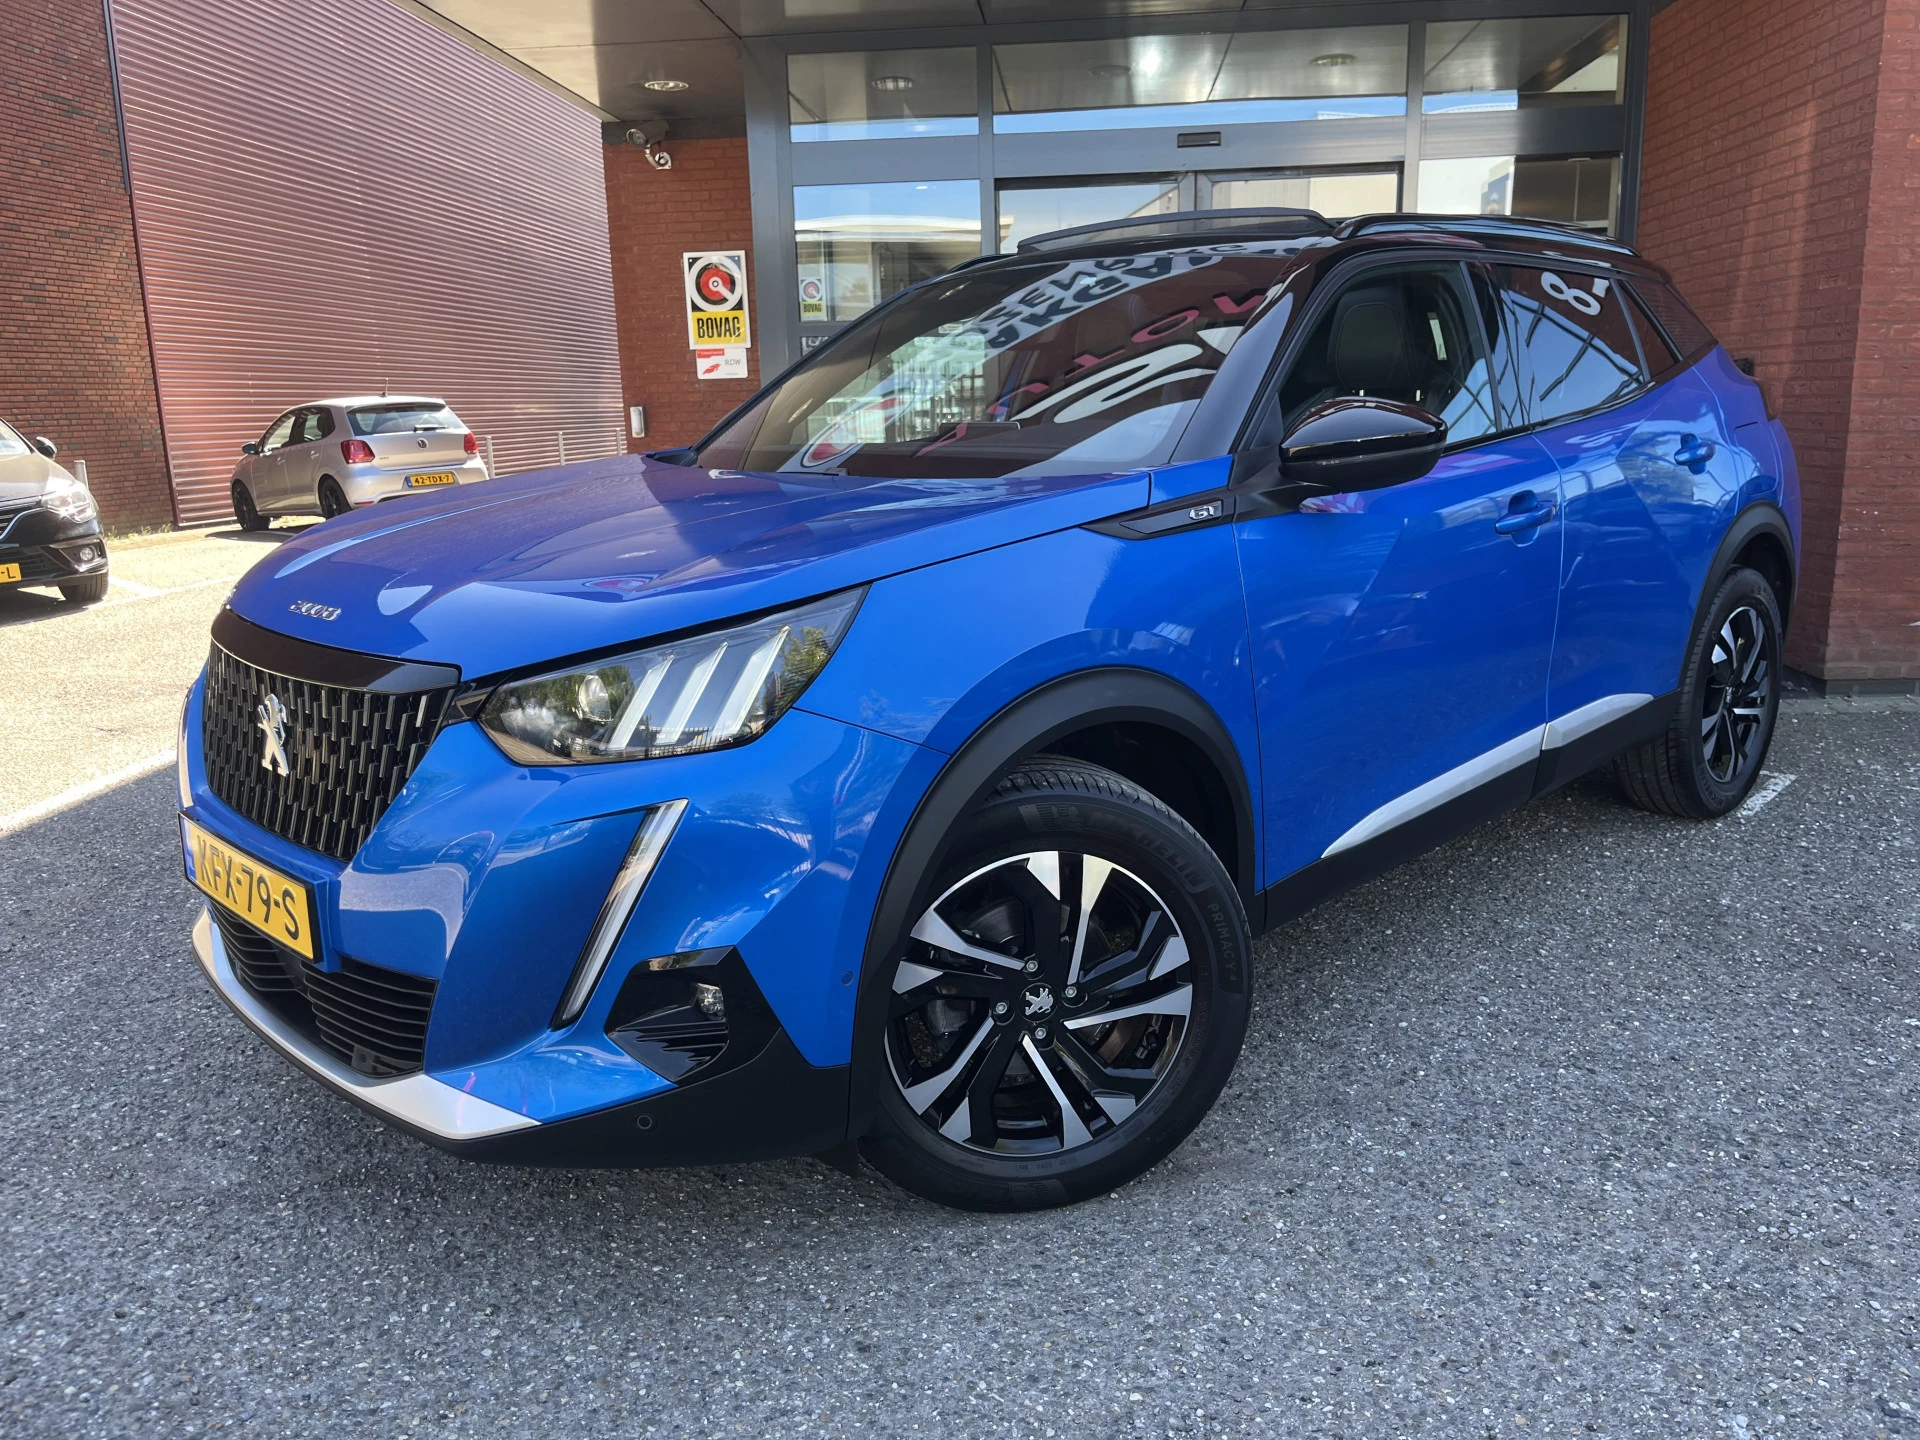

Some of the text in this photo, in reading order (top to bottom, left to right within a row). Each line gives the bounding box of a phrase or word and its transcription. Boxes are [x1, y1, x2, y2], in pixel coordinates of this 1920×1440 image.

[803, 303, 822, 313] BOVAG
[696, 316, 741, 339] BOVAG
[288, 600, 342, 621] 2008
[197, 834, 300, 941] KFX-79-S
[1206, 901, 1237, 972] PRIMACY
